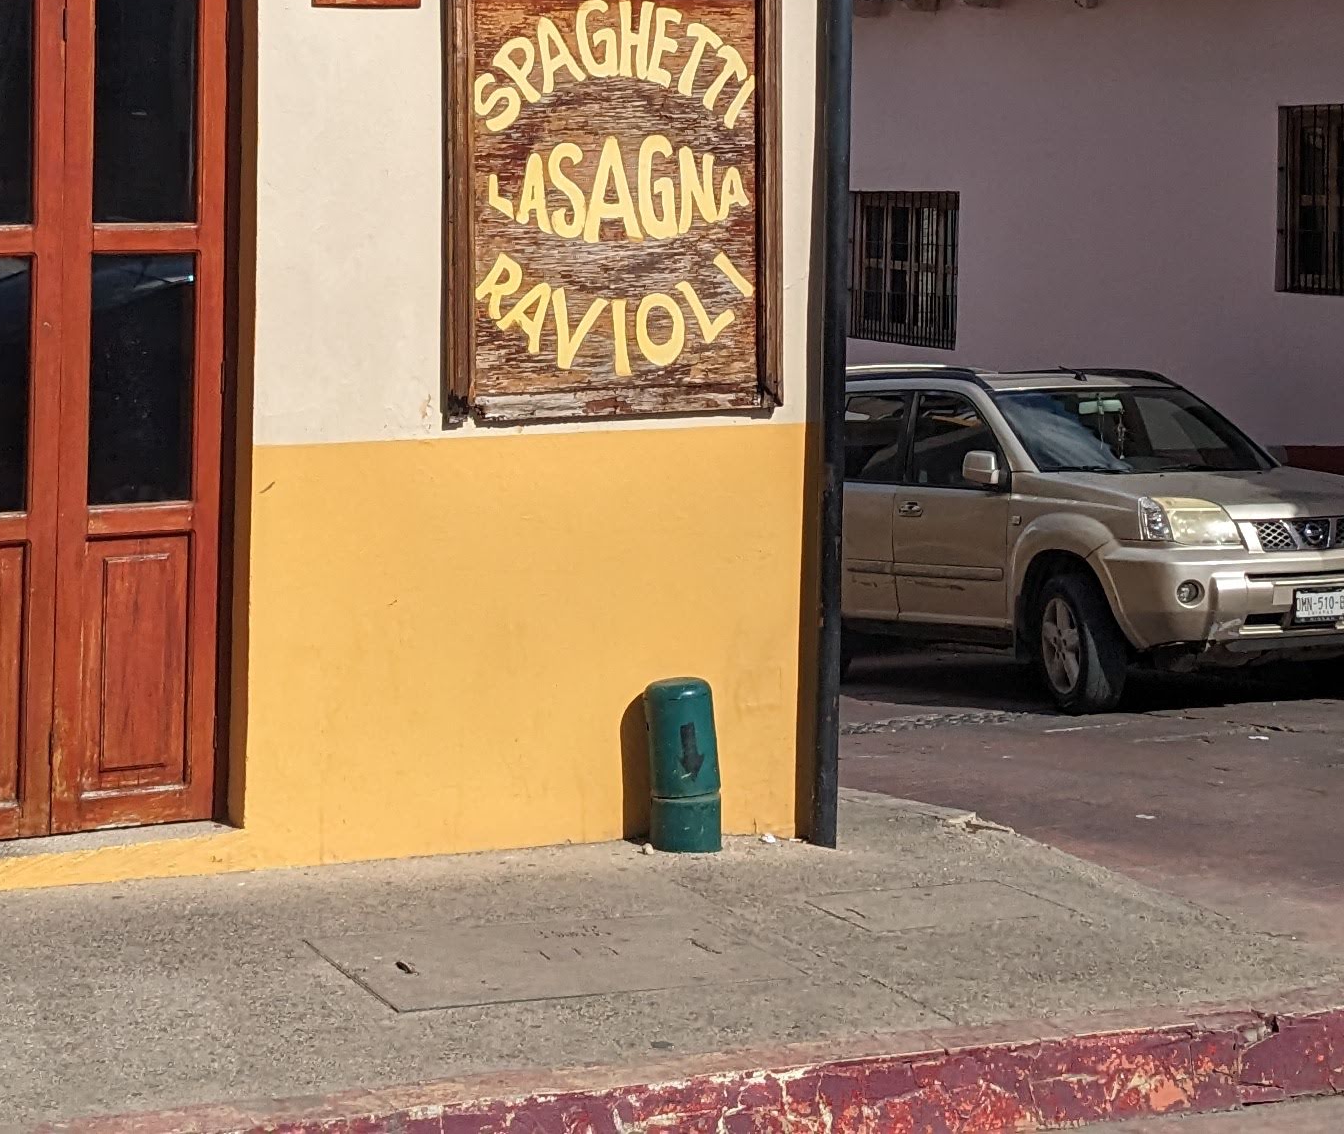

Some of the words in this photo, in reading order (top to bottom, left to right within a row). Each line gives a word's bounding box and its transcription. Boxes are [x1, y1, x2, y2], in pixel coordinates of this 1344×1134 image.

[474, 0, 755, 132] SPAGHETTI
[488, 135, 749, 243] LASAGNA
[475, 252, 754, 376] RAVIOLI
